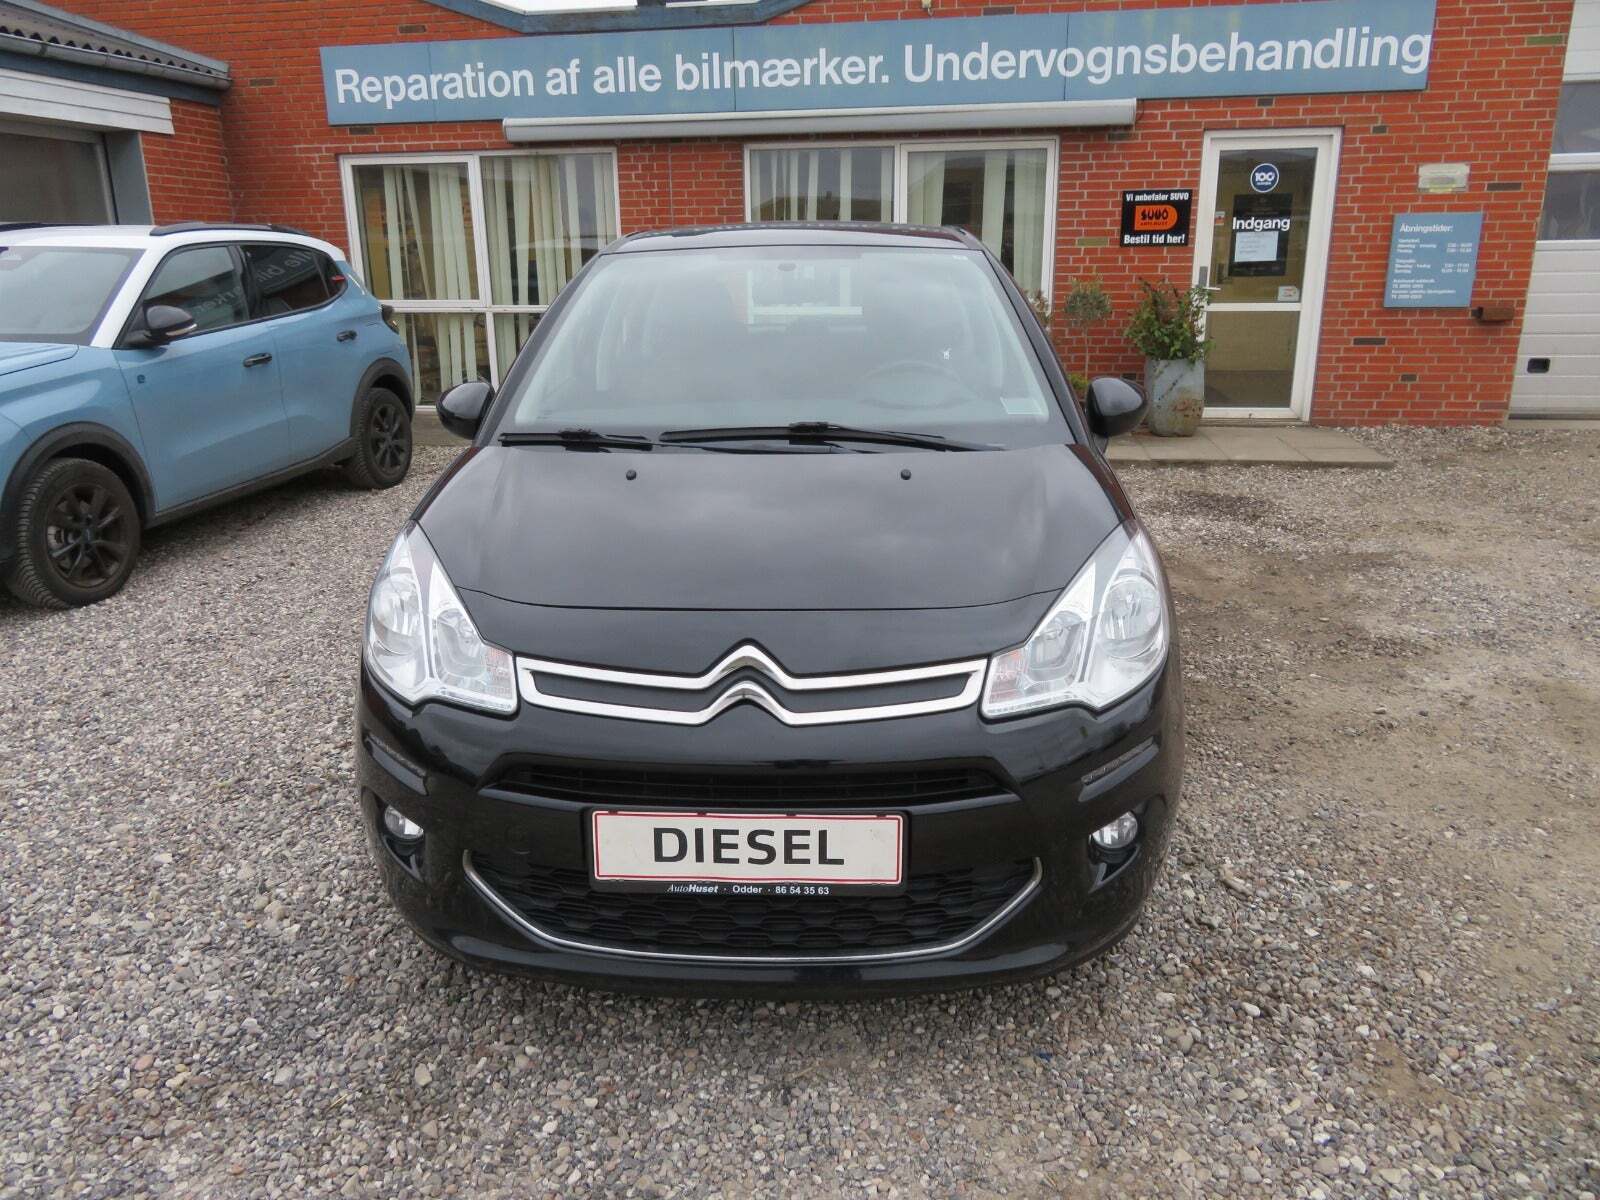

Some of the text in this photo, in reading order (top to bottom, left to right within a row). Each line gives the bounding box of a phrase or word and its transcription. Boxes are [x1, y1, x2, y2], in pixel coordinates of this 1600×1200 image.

[335, 26, 1432, 110] Reparation af alle bilmærker. Undervognsbehandling
[1126, 192, 1189, 202] Vi anbefaler SUVO
[1232, 217, 1291, 232] Indgang
[1124, 234, 1186, 244] Bestil tid her!
[653, 827, 845, 866] DIESEL
[666, 884, 830, 896] AutoHuset Odder 86 54 35 63
